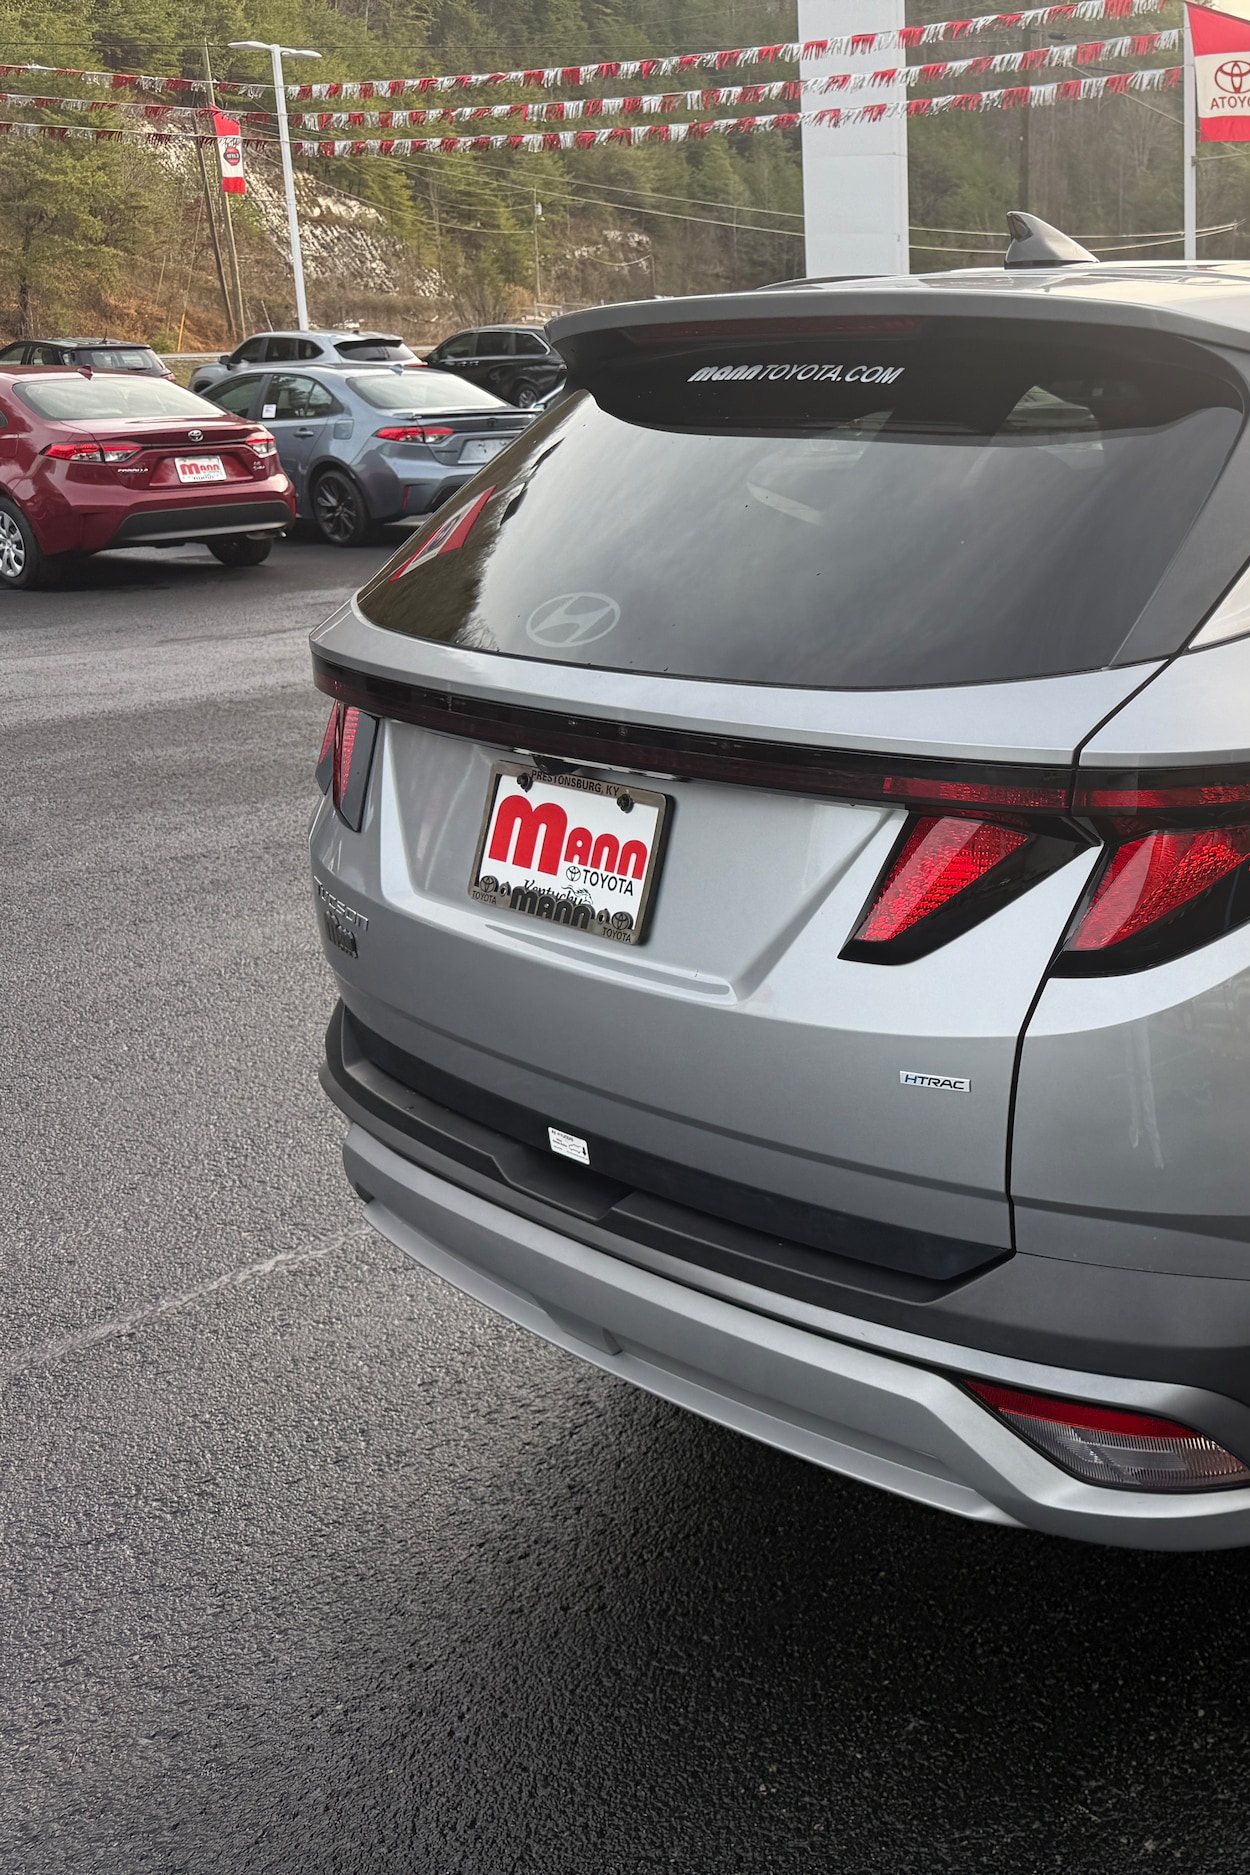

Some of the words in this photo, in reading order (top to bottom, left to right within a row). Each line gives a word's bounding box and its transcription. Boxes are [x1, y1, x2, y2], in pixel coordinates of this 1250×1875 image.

[606, 784, 620, 797] KY
[582, 868, 634, 896] TOYOTA
[472, 889, 497, 905] TOYOTA
[602, 926, 632, 943] TOYOTA
[904, 1074, 965, 1090] HTRAC
